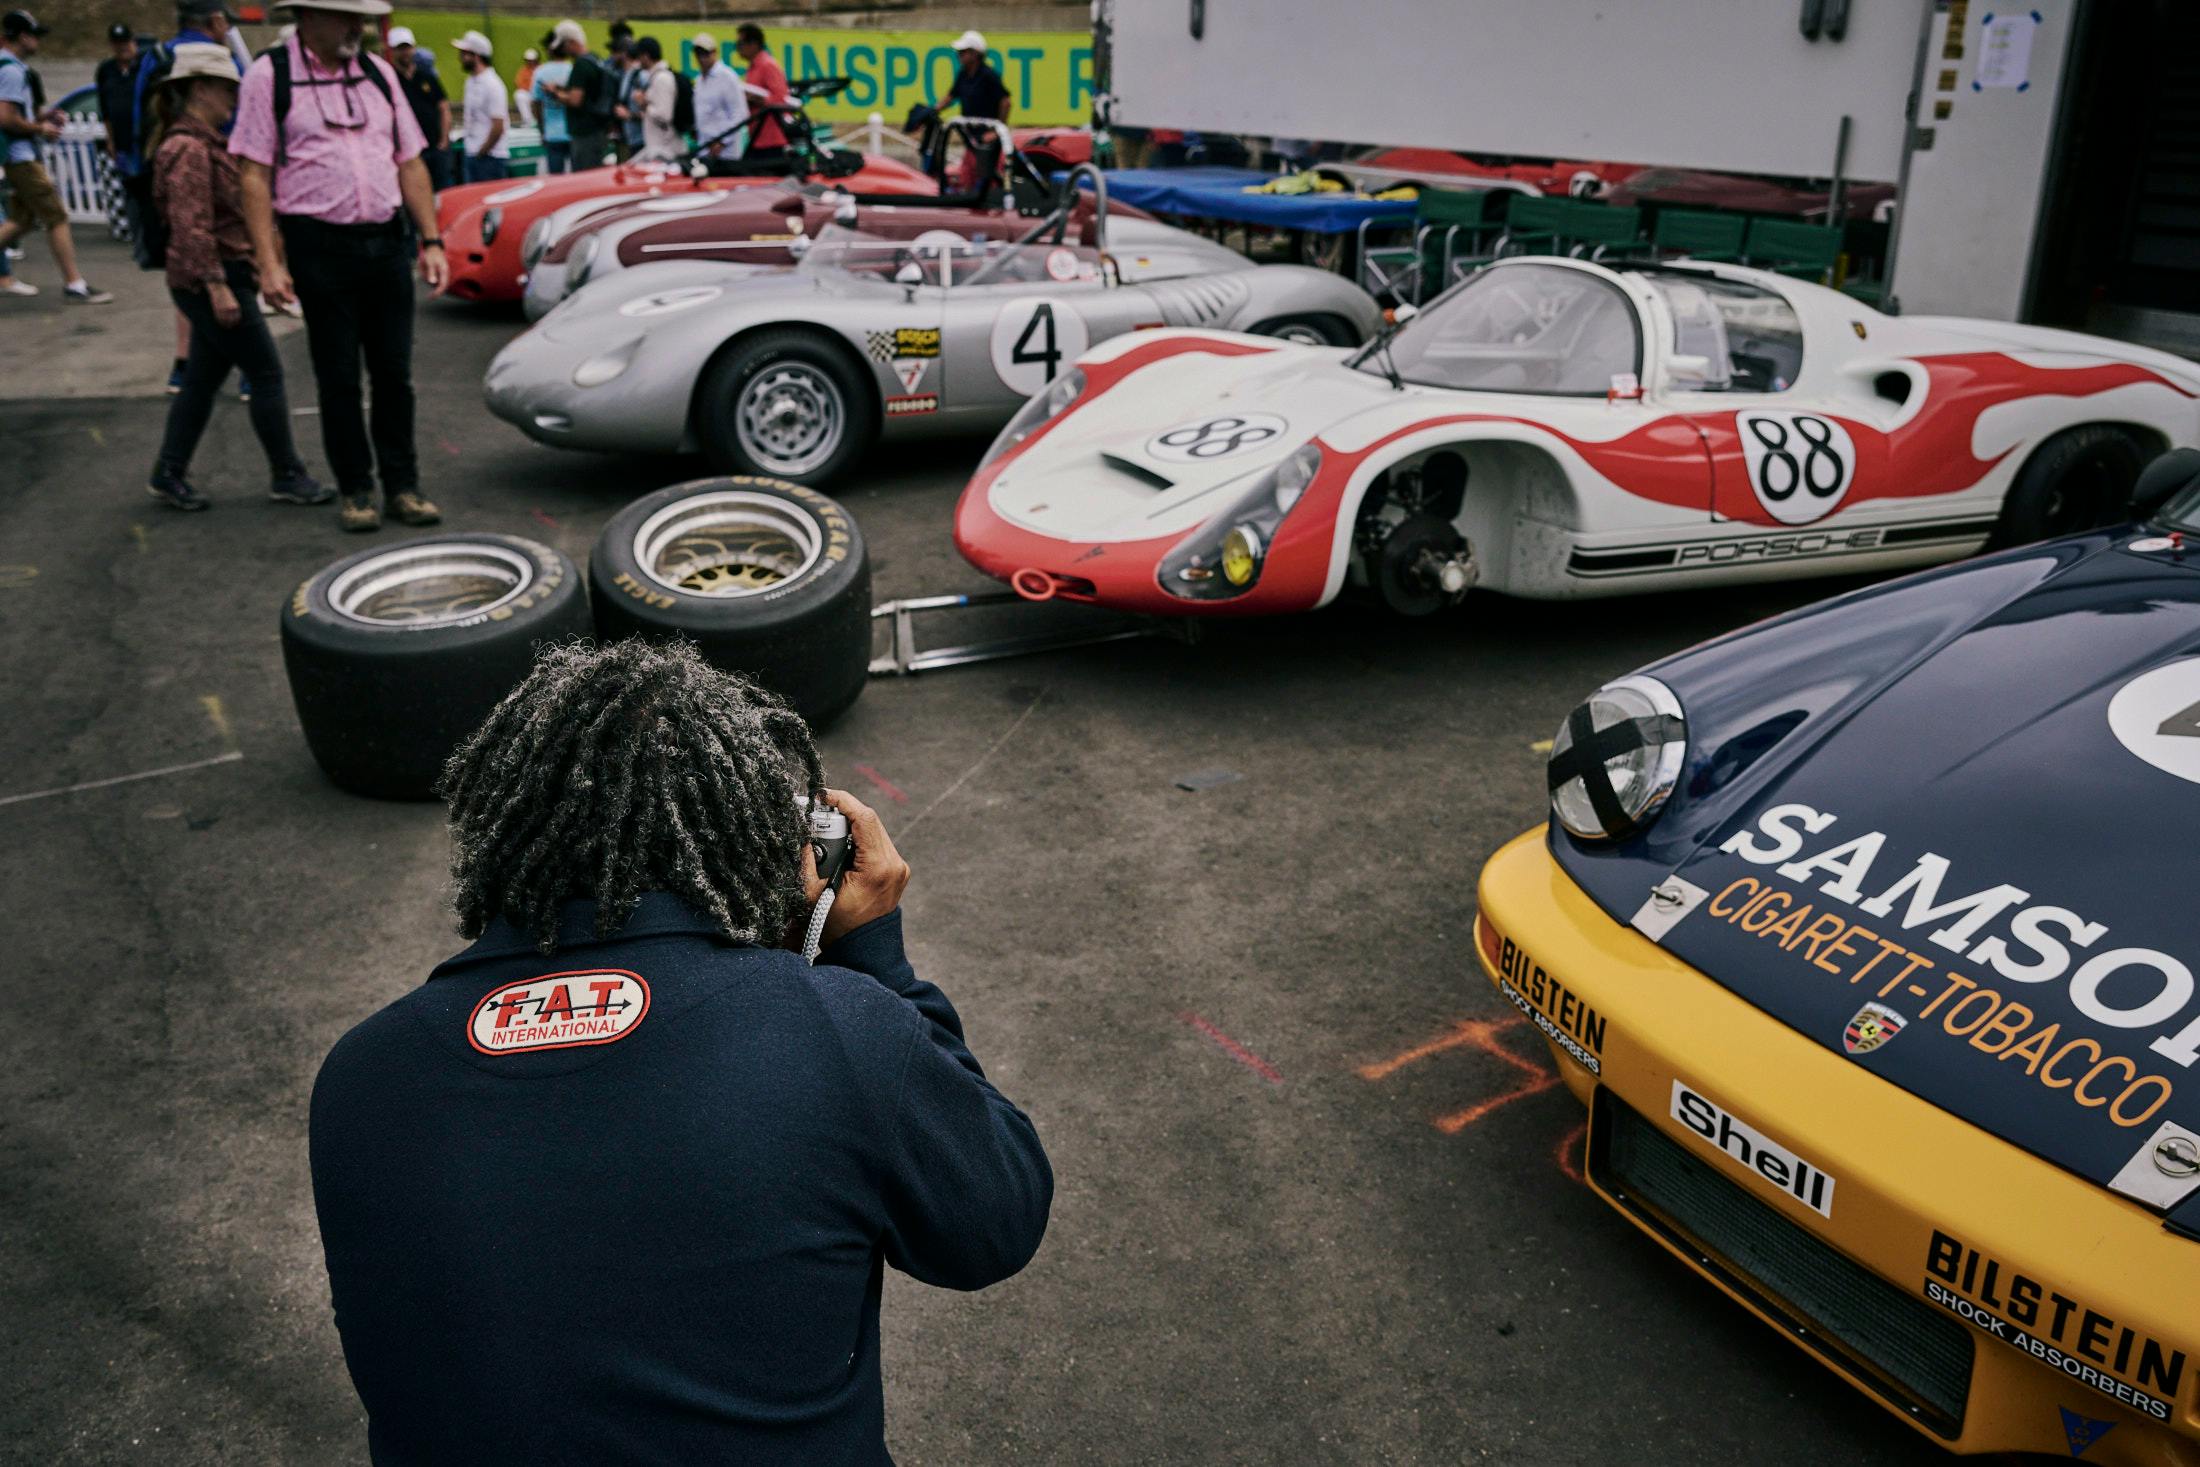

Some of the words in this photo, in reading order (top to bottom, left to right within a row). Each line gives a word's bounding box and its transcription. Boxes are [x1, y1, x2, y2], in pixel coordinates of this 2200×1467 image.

[1012, 303, 1061, 384] 4
[1158, 418, 1276, 458] 88
[1748, 415, 1843, 501] 88
[1679, 530, 1881, 565] PORSCHE
[491, 1019, 620, 1045] INTERNATIONAL
[1501, 937, 1607, 1055] BILSTEIN
[1501, 979, 1531, 1016] SHOCK
[1534, 1013, 1600, 1074] ABSORBERS
[1709, 877, 2172, 1127] CIGARETT-TOBACCO
[1678, 1090, 1825, 1210] Shell
[1926, 1229, 2186, 1398] BILSTEIN
[1928, 1282, 2006, 1338] SHOCK
[2013, 1332, 2167, 1420] ABSORBERS
